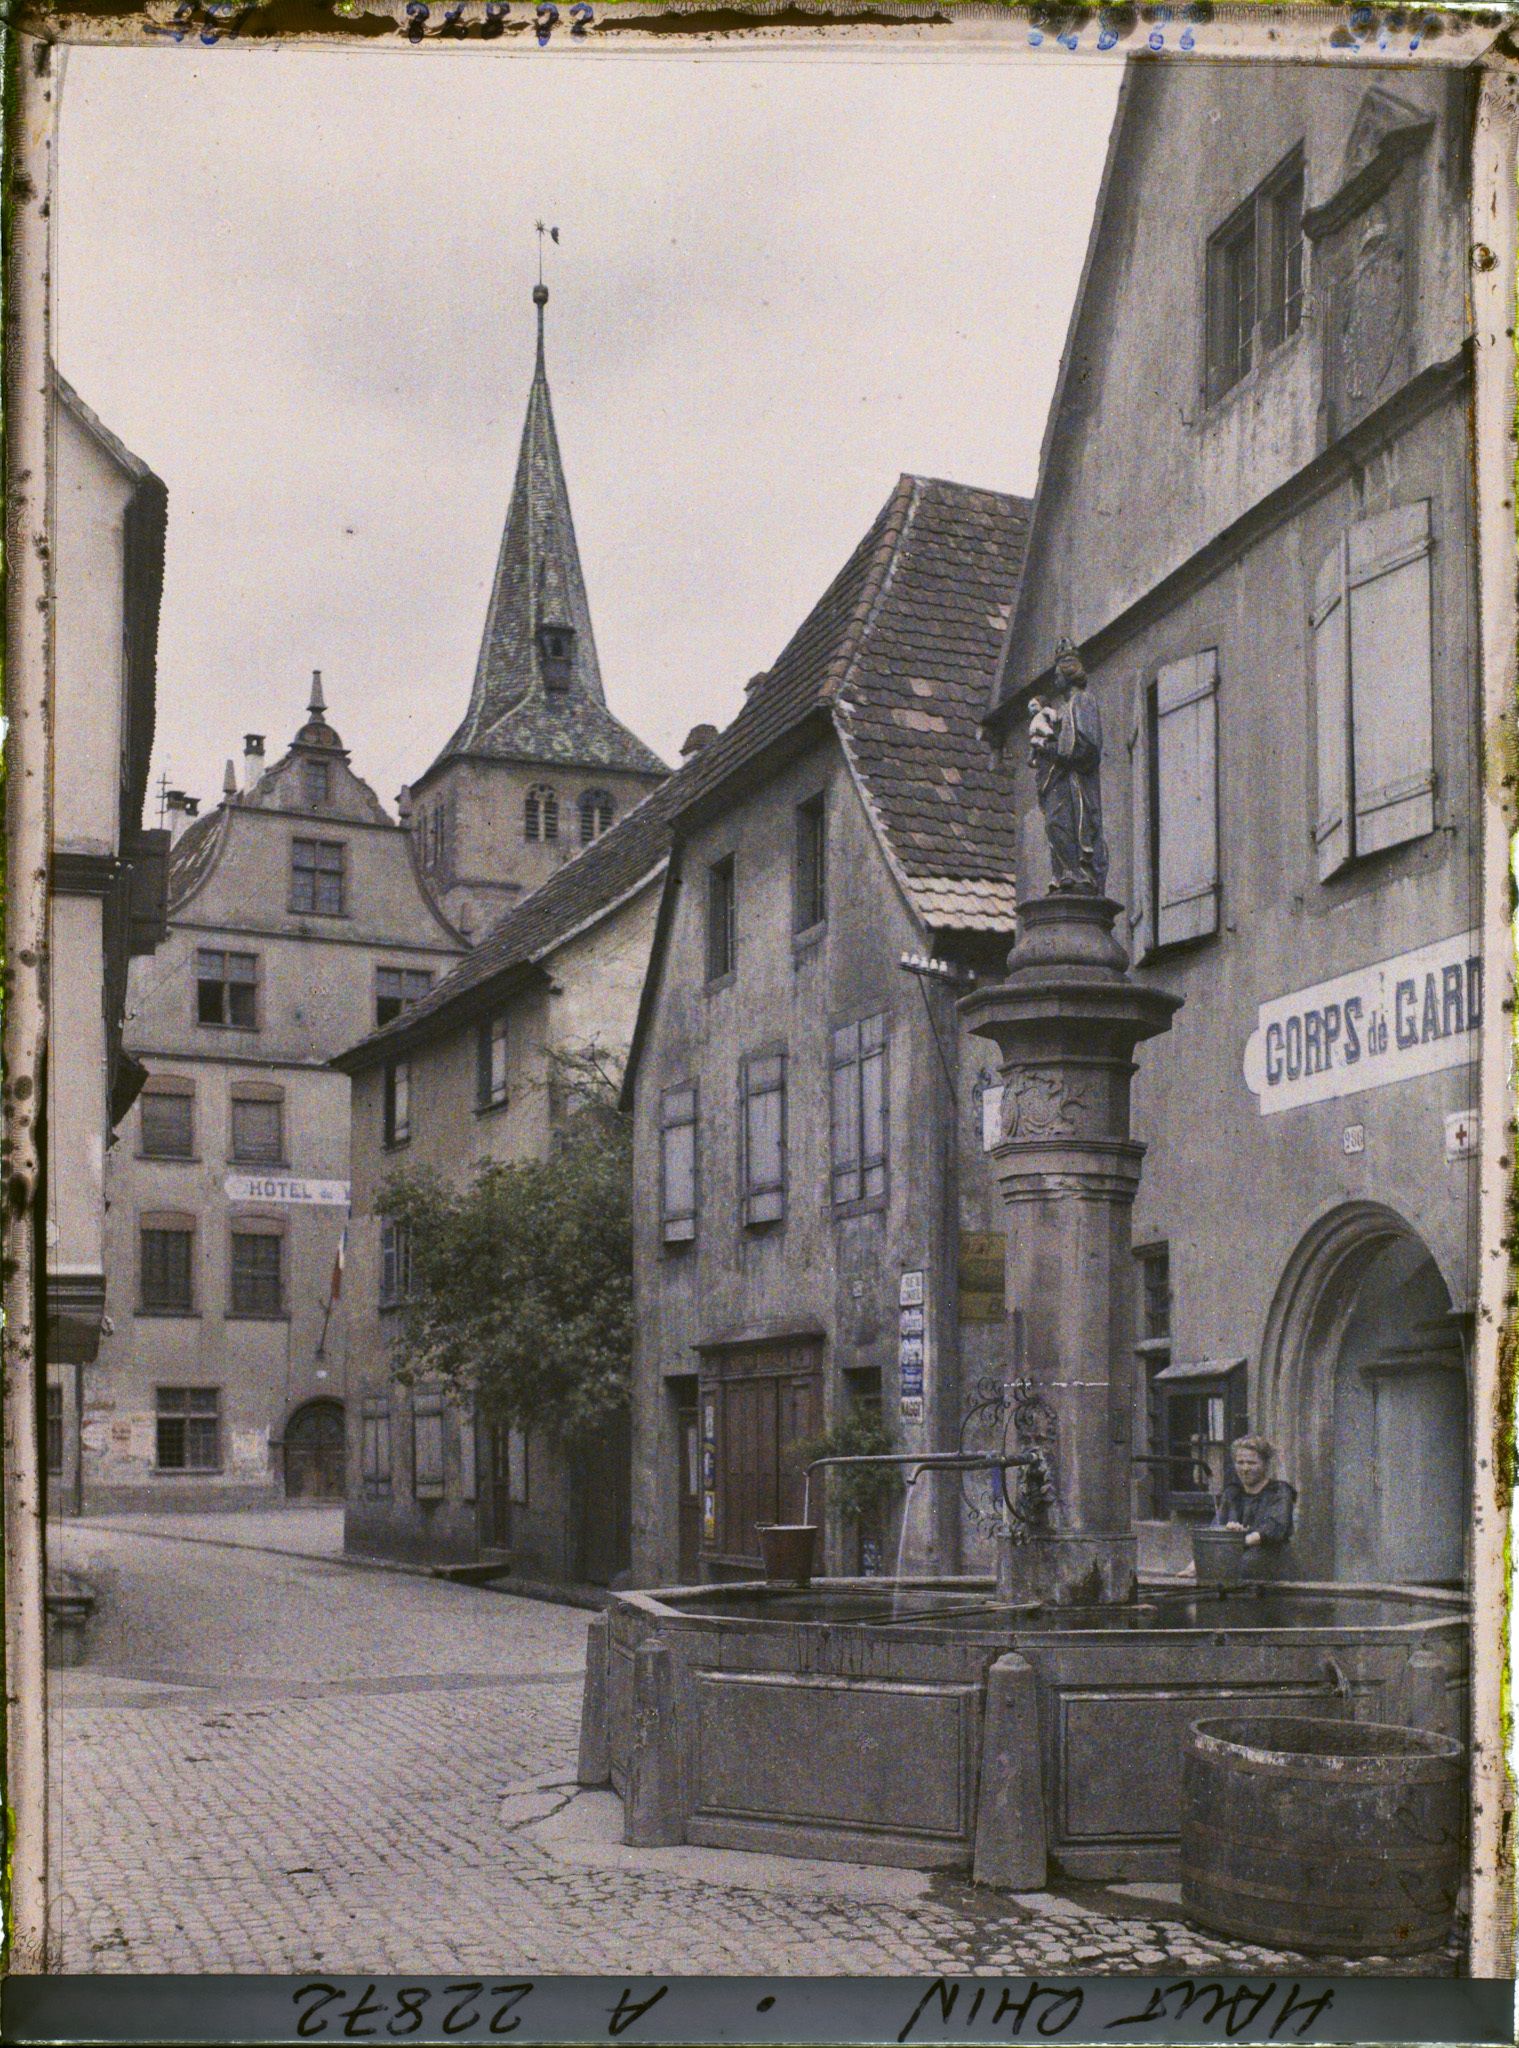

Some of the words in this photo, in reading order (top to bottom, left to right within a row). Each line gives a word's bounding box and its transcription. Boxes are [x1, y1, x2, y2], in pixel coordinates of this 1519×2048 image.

[1266, 996, 1363, 1086] CORPS
[1368, 1009, 1389, 1056] de
[292, 1982, 534, 2036] 22872
[605, 1986, 668, 2036] A
[898, 1978, 1084, 2042] RHIN
[1103, 1979, 1335, 2038] HAUT
